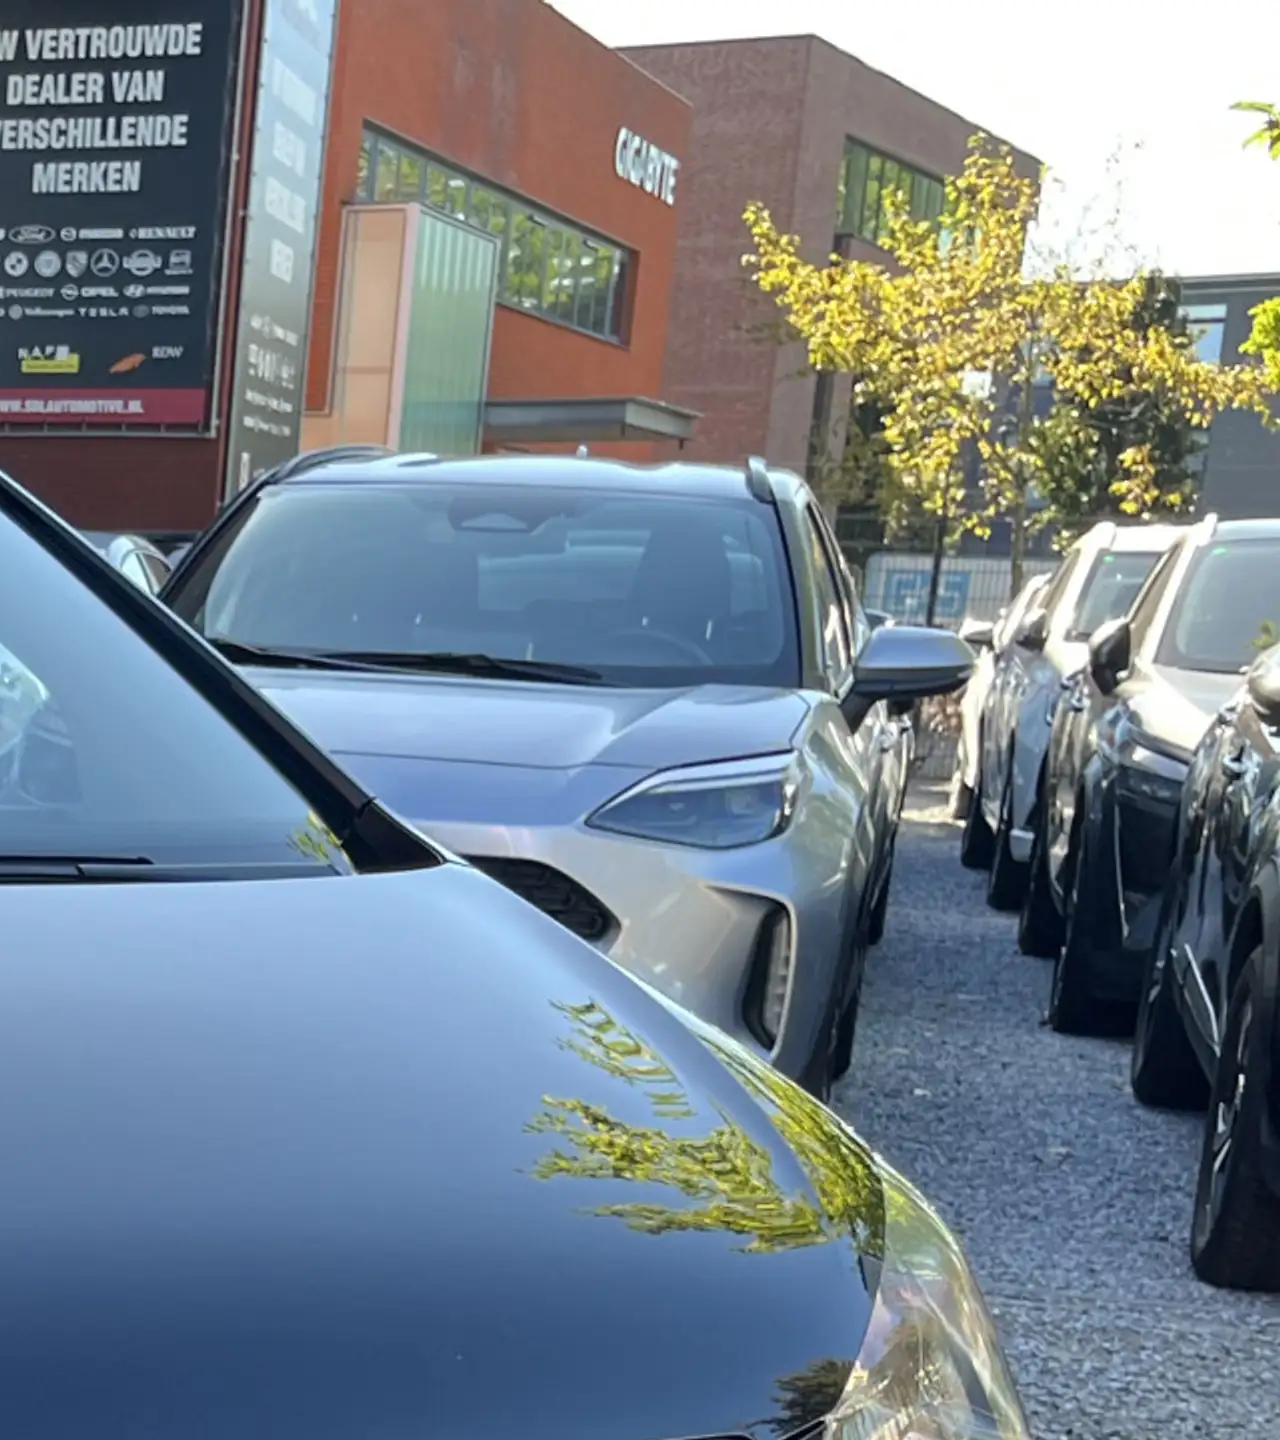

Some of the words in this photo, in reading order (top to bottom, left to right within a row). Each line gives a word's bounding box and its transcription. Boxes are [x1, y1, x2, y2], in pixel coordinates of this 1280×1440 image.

[26, 23, 202, 60] VERTROUWDE
[6, 73, 103, 105] DEALER
[112, 70, 164, 102] VAN
[32, 161, 141, 193] MERKEN
